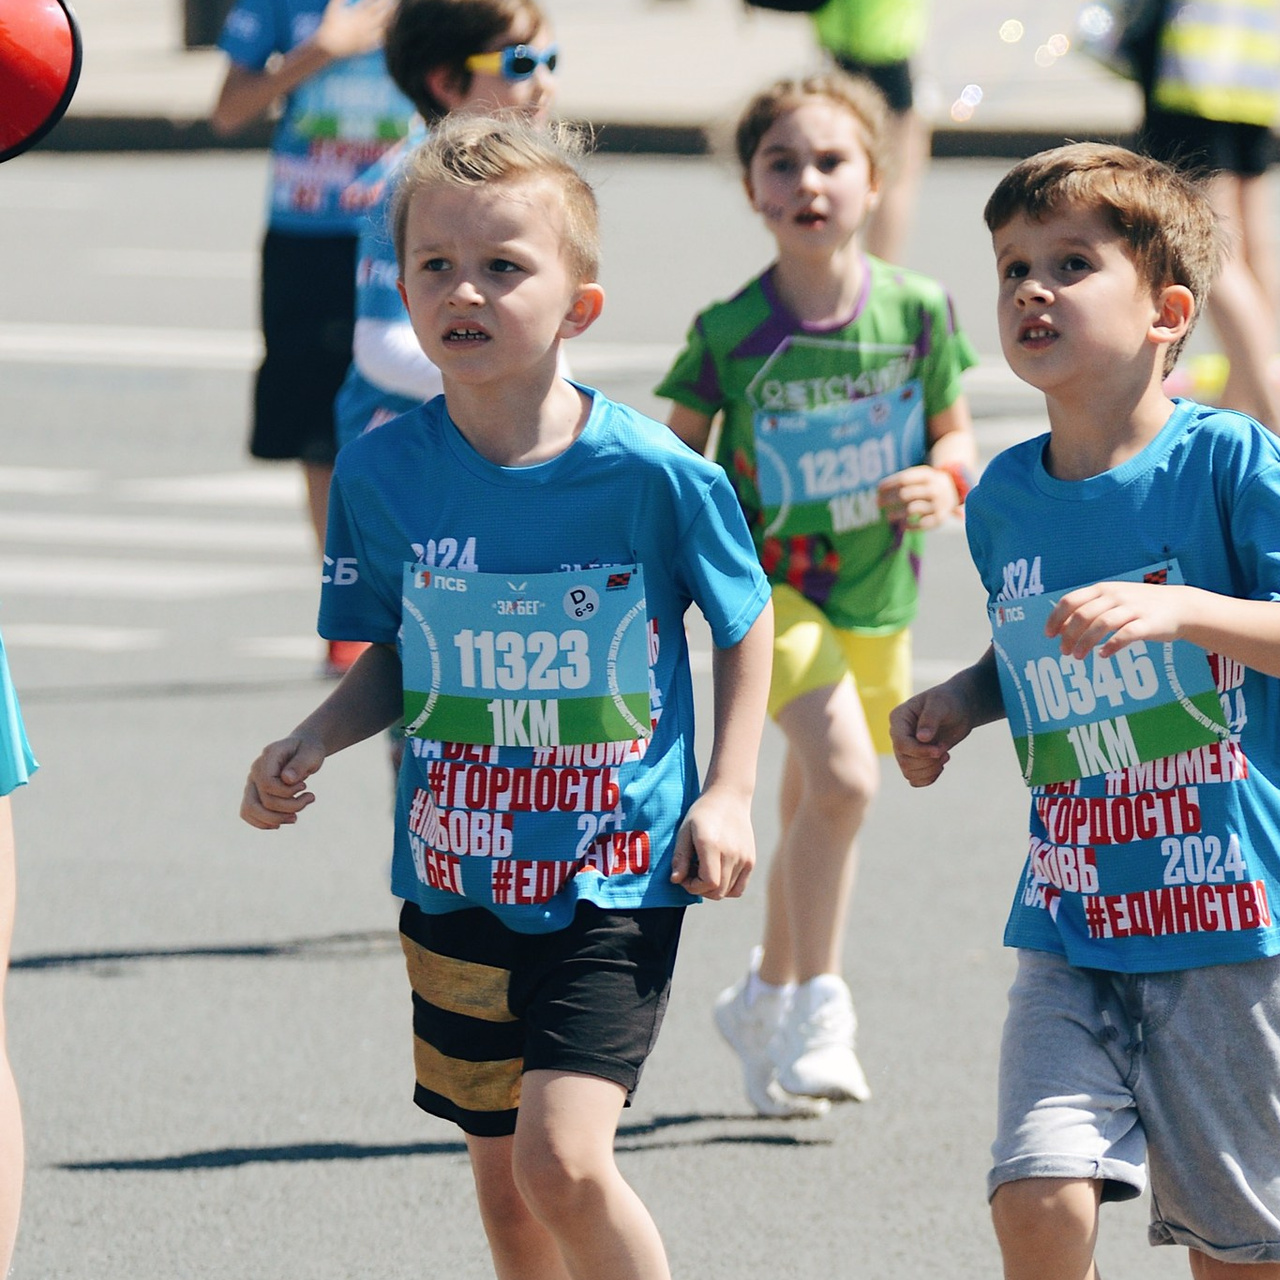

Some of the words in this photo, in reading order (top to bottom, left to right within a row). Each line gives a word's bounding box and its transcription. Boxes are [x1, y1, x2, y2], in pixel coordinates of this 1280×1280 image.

[434, 575, 467, 592] ПСБ
[570, 589, 586, 605] D
[575, 602, 595, 618] 6-9
[1005, 606, 1025, 623] ПСБ
[454, 628, 591, 691] 11323
[1023, 640, 1159, 724] 10346
[427, 760, 620, 813] #ГОРДОСТЬ
[1161, 833, 1246, 885] 2024
[1082, 879, 1272, 939] #ЕДИНСТВО
